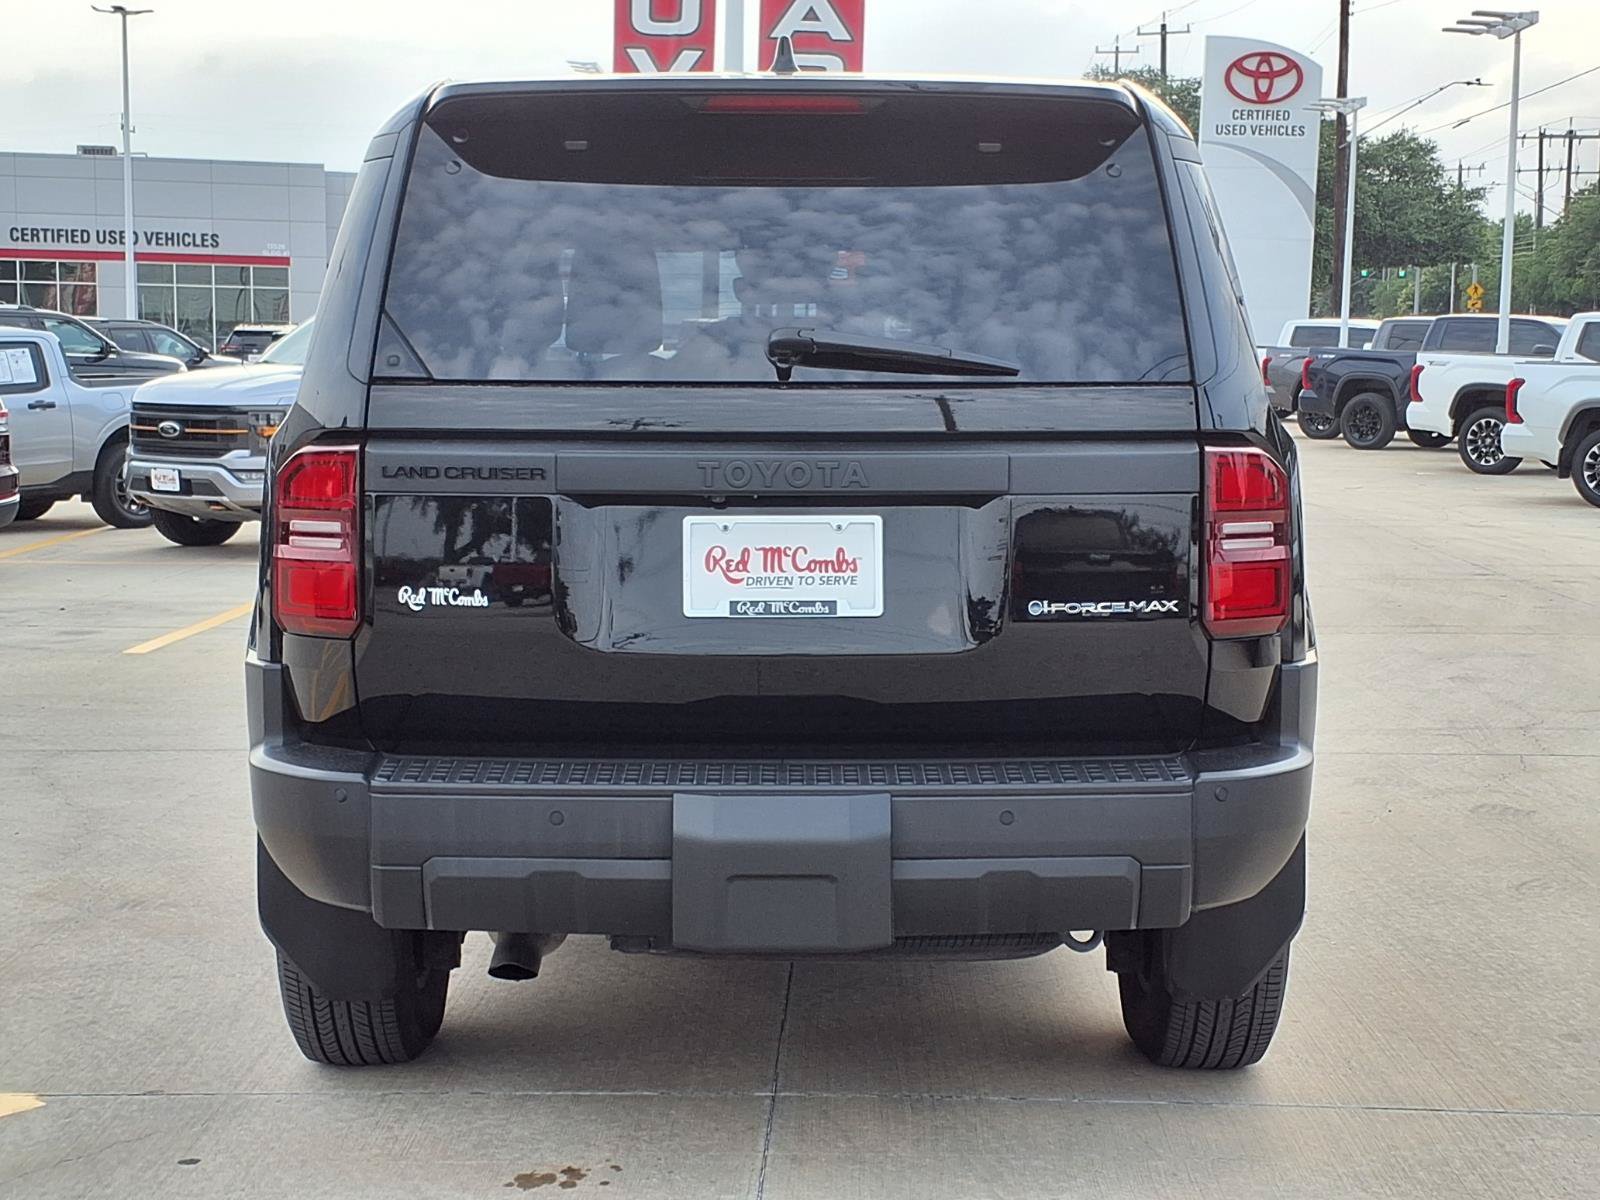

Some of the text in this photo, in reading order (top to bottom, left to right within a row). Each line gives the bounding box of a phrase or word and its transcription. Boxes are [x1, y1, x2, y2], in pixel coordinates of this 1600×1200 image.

[1232, 109, 1290, 121] CERTIFIED
[1215, 124, 1306, 137] USED VEHICLES
[9, 226, 91, 244] CERTIFIED
[144, 231, 220, 248] VEHICLES
[381, 466, 547, 480] LAND CRUISER
[697, 460, 870, 488] TOYOTA
[704, 545, 858, 584] Red McCombs
[745, 575, 858, 587] DRIVEN TO SERVE
[398, 585, 489, 611] Red McCombs
[736, 601, 765, 615] Red
